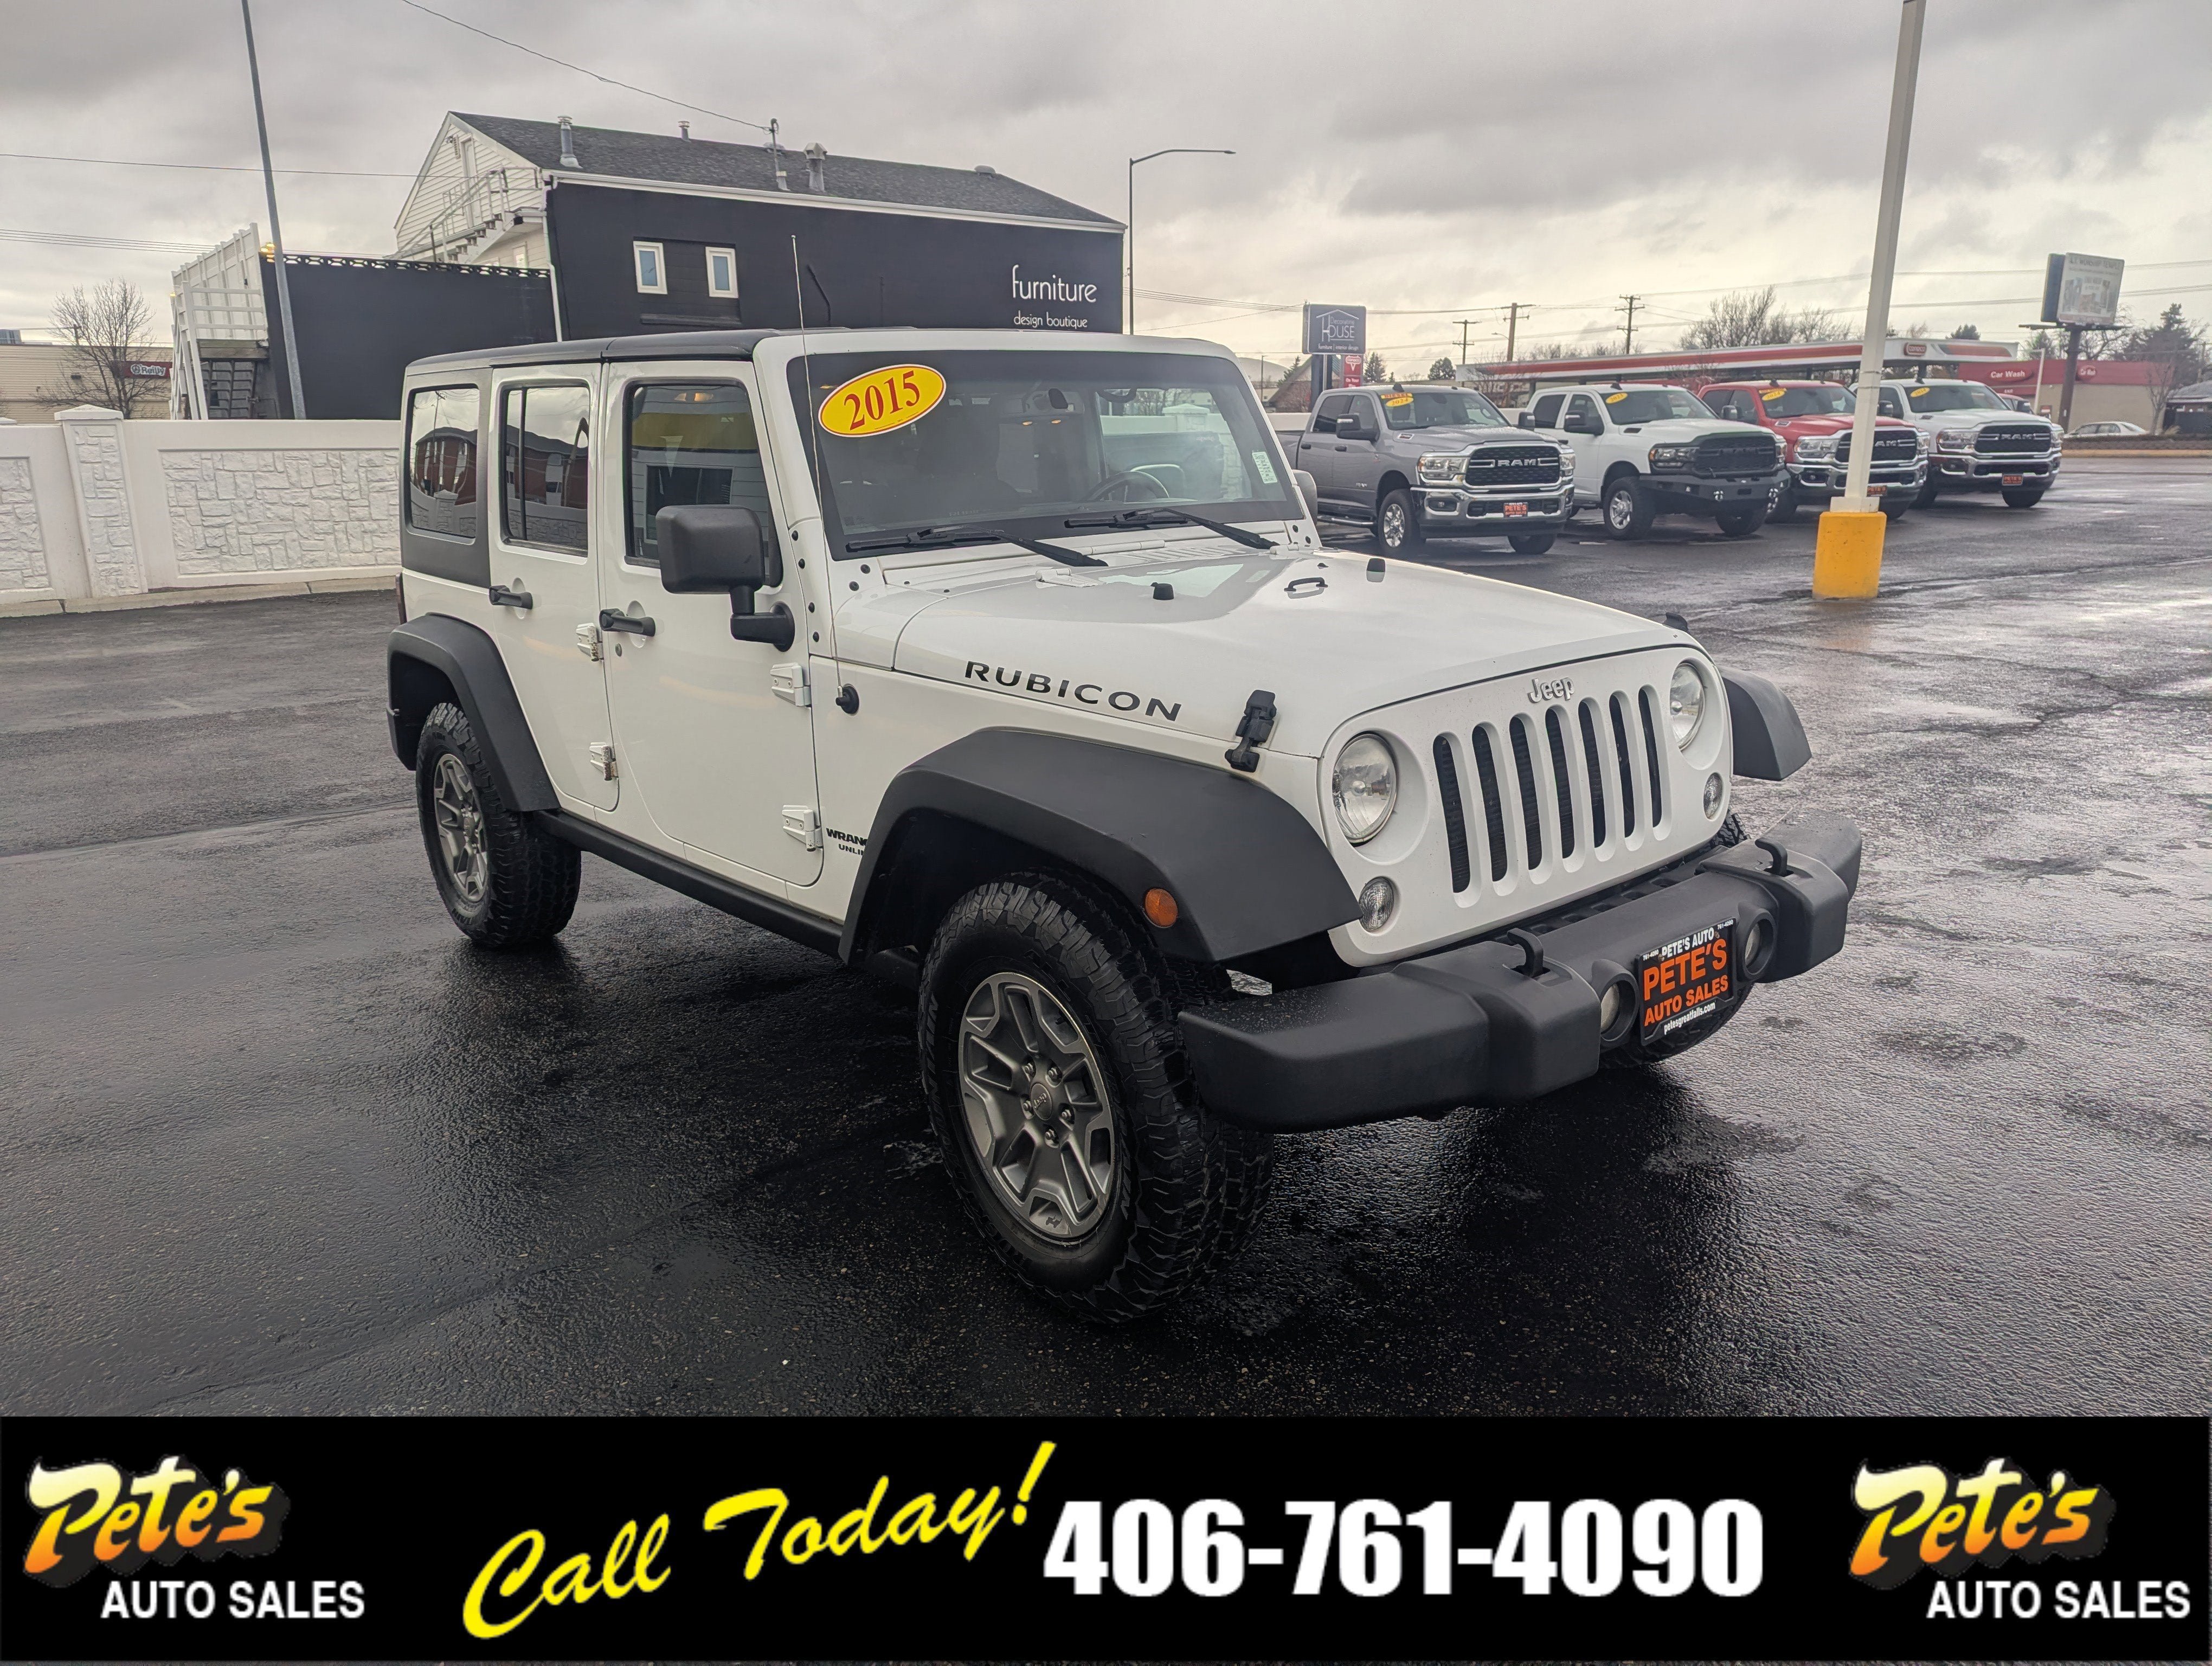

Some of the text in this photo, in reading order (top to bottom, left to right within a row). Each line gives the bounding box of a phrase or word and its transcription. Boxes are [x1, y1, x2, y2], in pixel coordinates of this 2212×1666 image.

[1012, 264, 1097, 303] furniture
[1013, 310, 1088, 329] design boutique
[844, 370, 920, 431] 2015
[1497, 459, 1536, 467] RAM
[964, 661, 1182, 722] RUBICON
[1527, 677, 1575, 704] Jeep
[1662, 927, 1714, 958] PETE'S AUTO
[1643, 938, 1727, 1002] PETE'S
[1644, 975, 1728, 1027] AUTO SALES
[1664, 1002, 1716, 1035] petesgreatfalls.com
